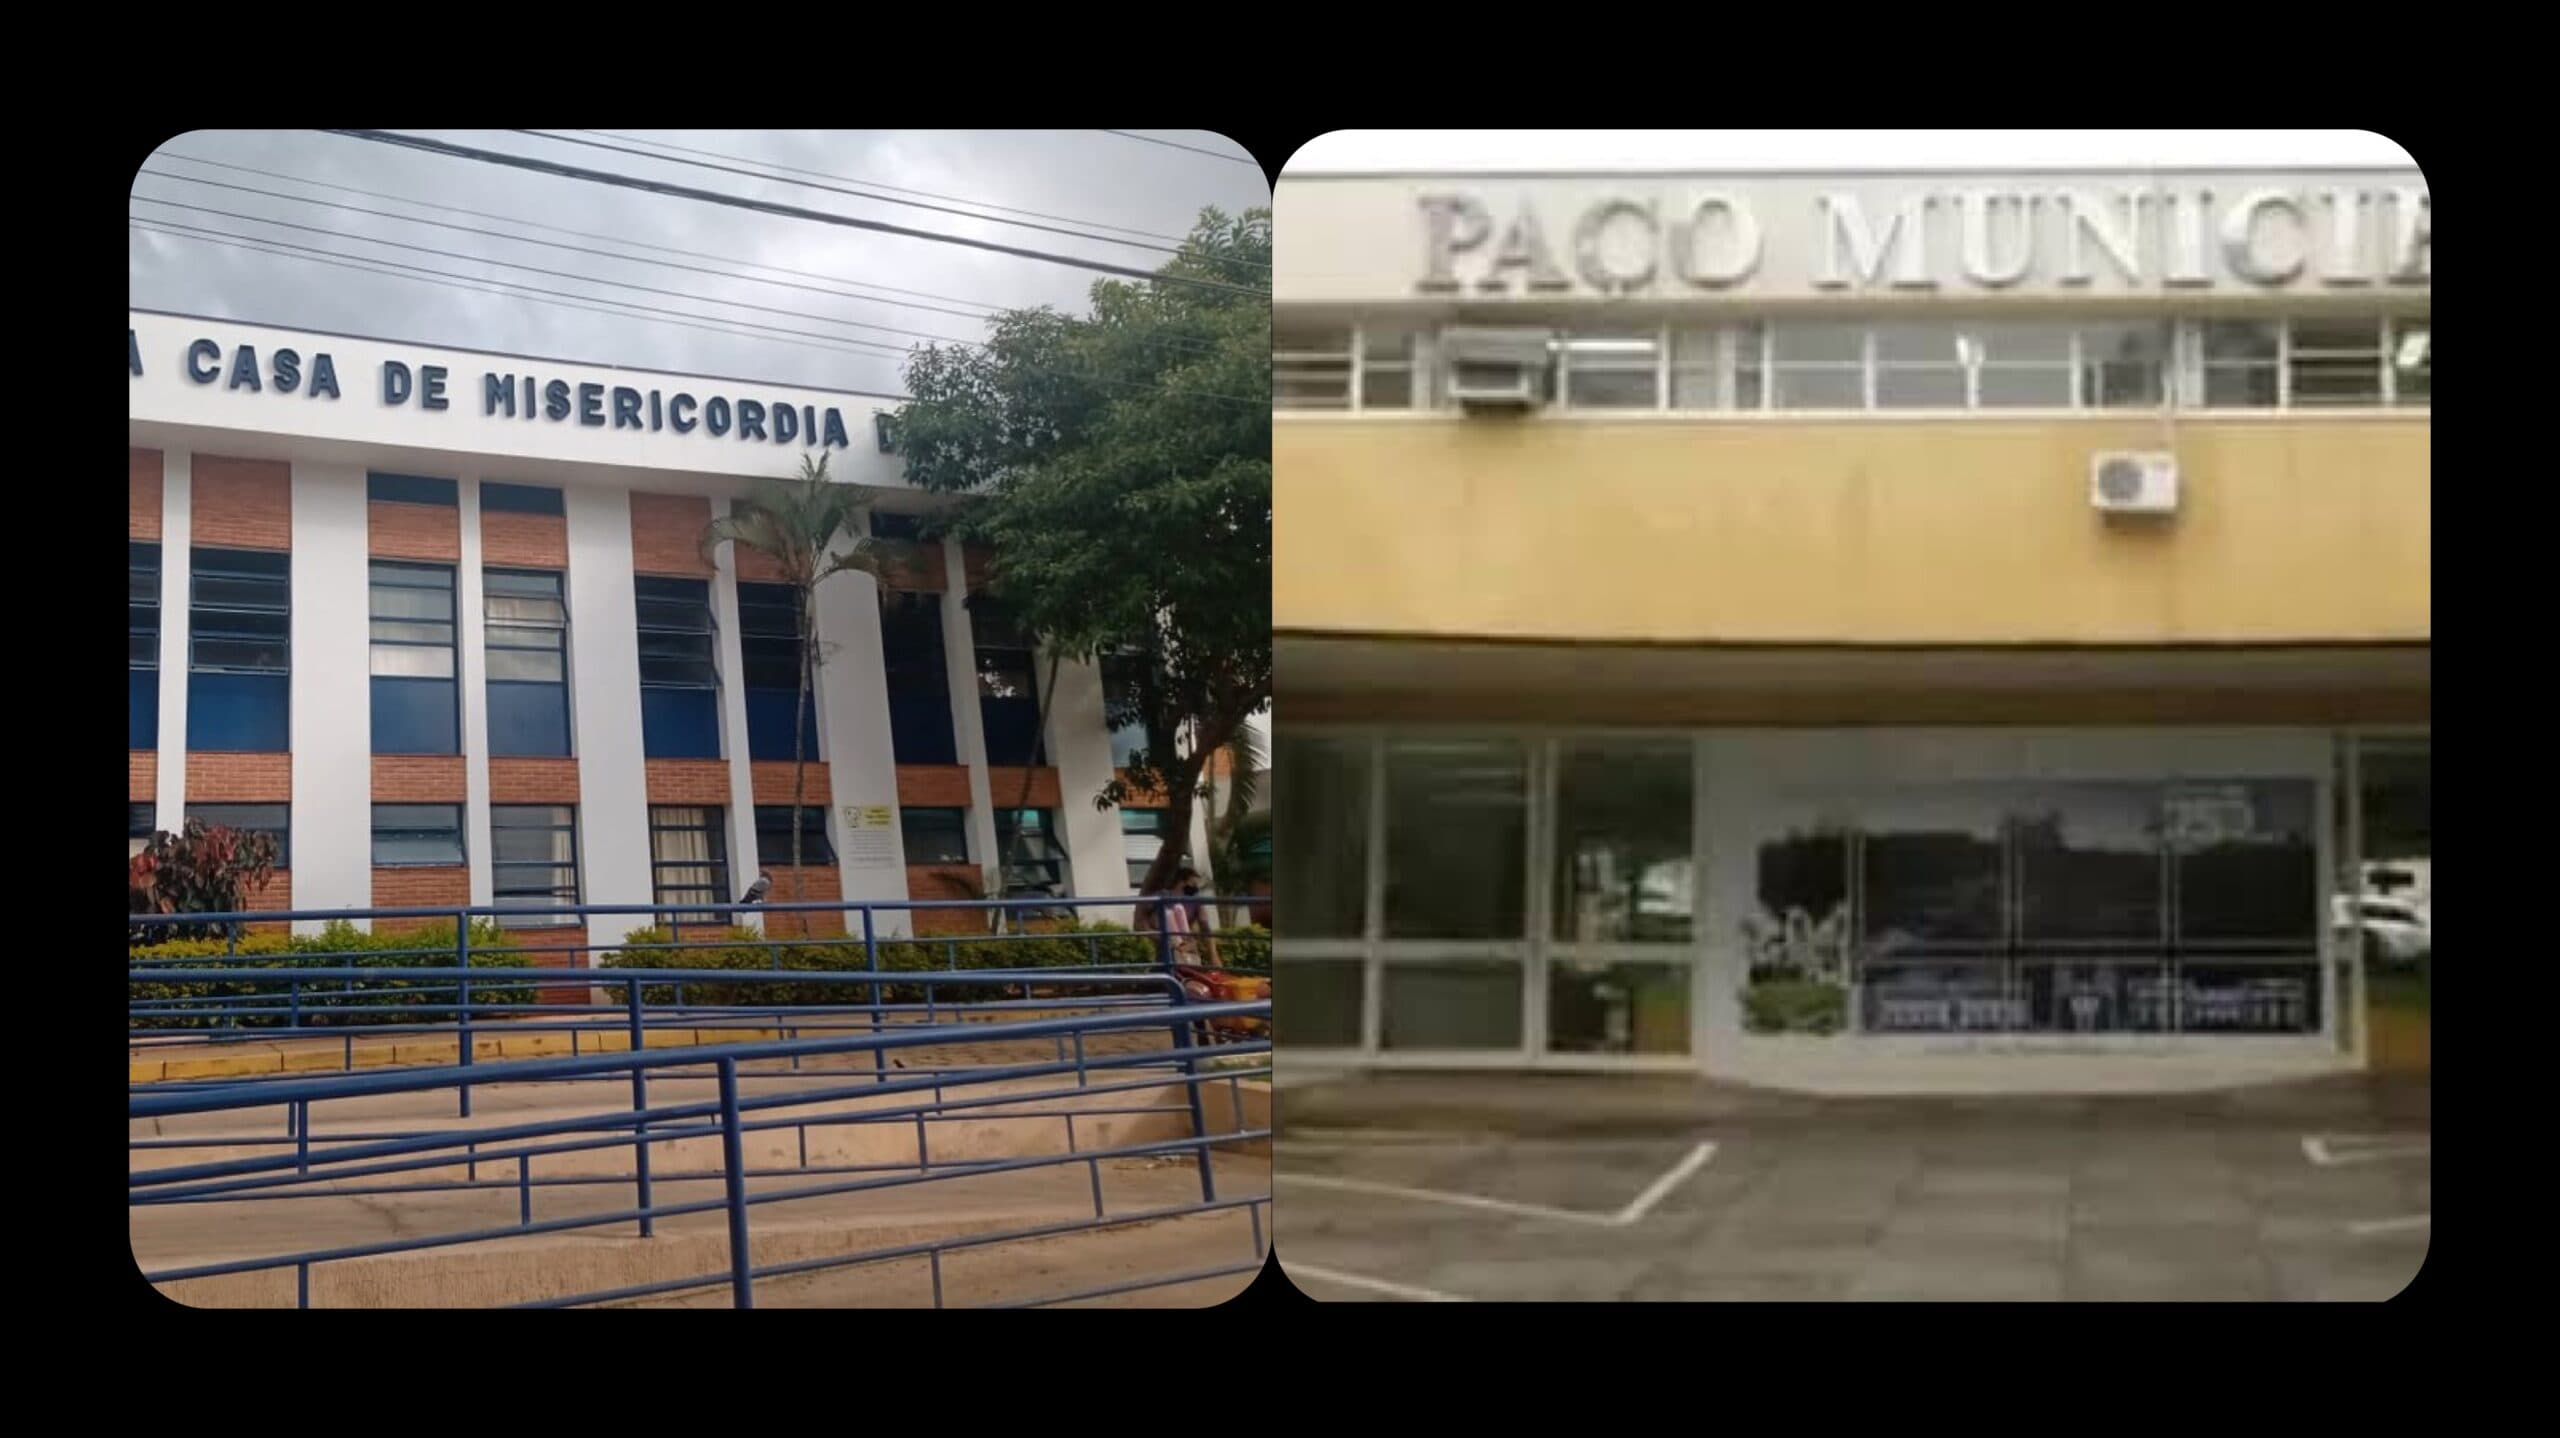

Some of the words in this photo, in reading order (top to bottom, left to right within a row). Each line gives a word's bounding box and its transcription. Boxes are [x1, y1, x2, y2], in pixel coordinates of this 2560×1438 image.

[1416, 193, 1764, 298] PAÇO
[187, 338, 340, 398] CASA
[383, 360, 449, 409] DE
[485, 373, 849, 449] MISERICORDIA
